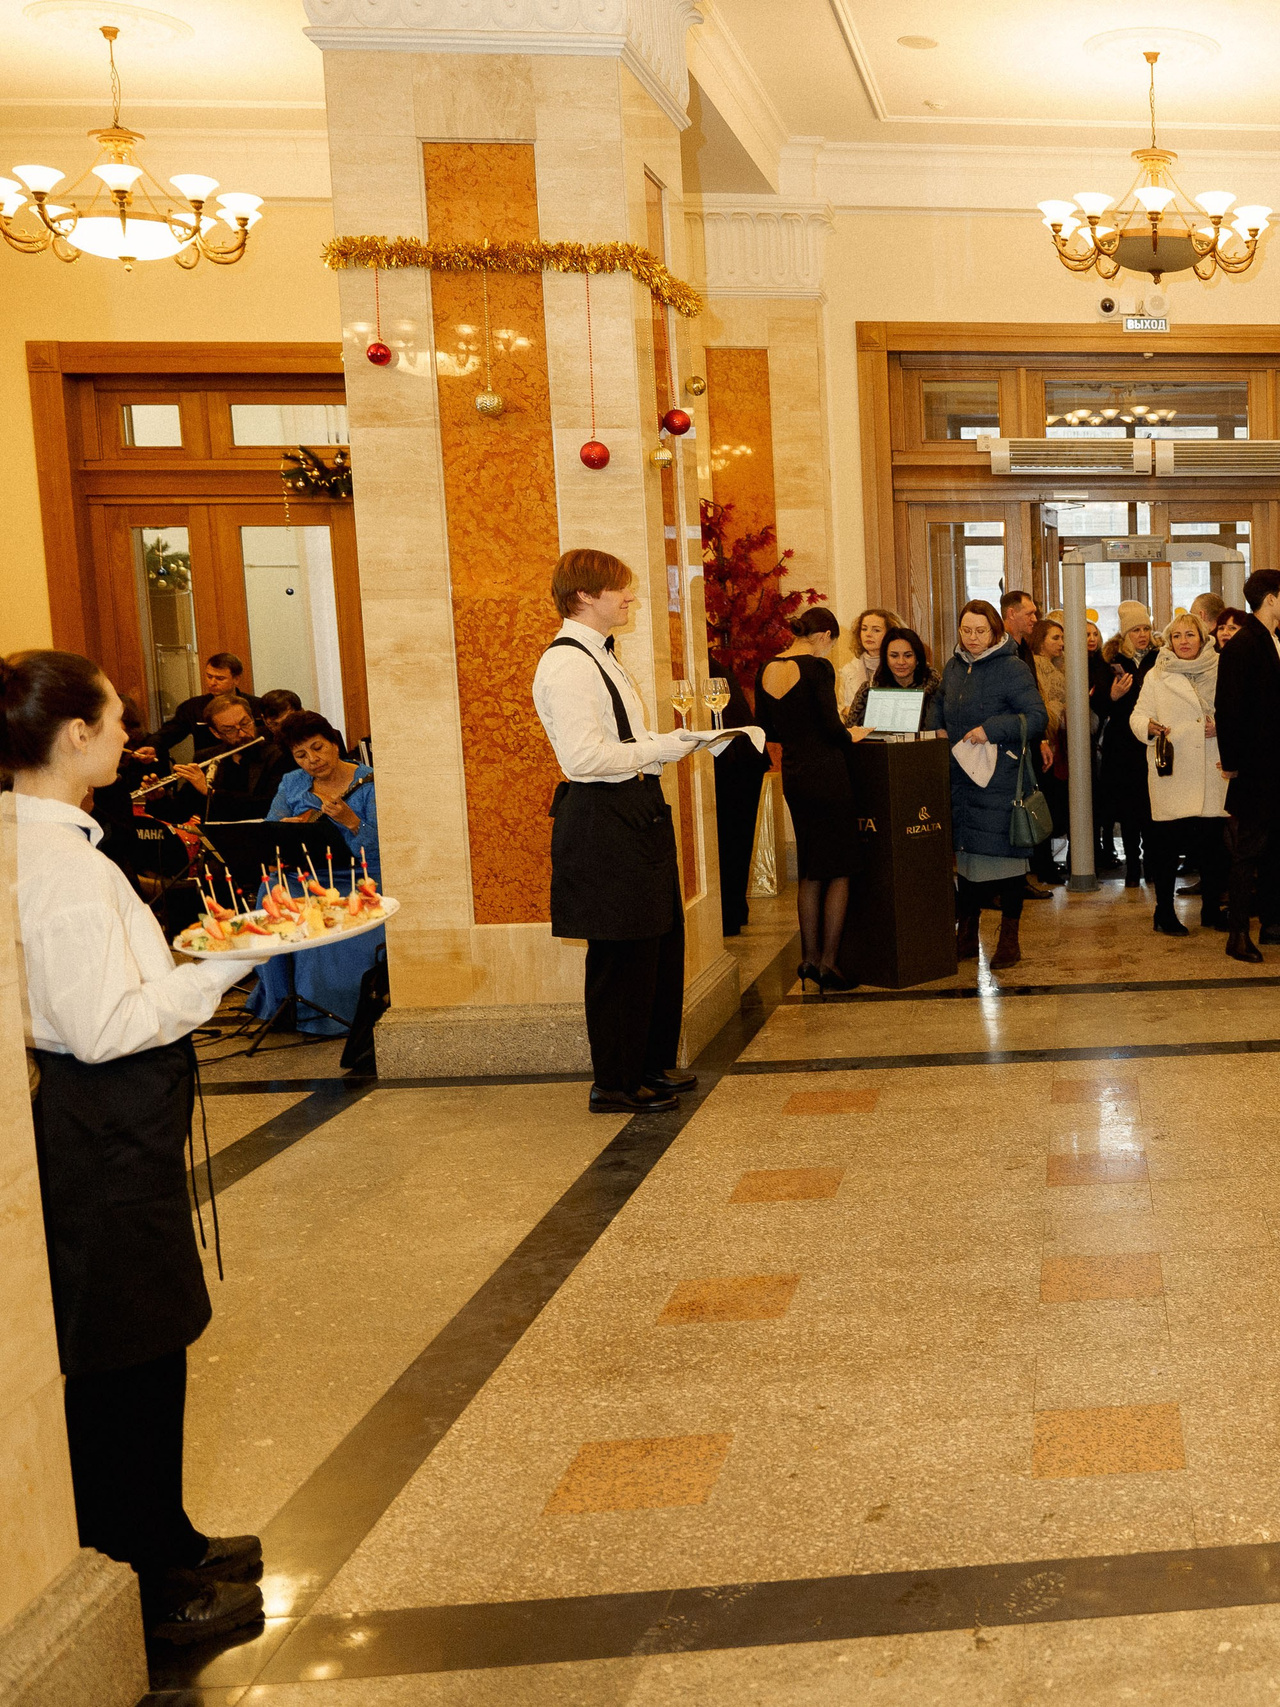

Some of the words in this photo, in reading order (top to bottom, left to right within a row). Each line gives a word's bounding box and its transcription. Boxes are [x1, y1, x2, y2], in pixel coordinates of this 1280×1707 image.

[1126, 319, 1166, 330] ВЫХОД
[136, 828, 165, 840] MAHA
[906, 822, 942, 834] RIZALTA
